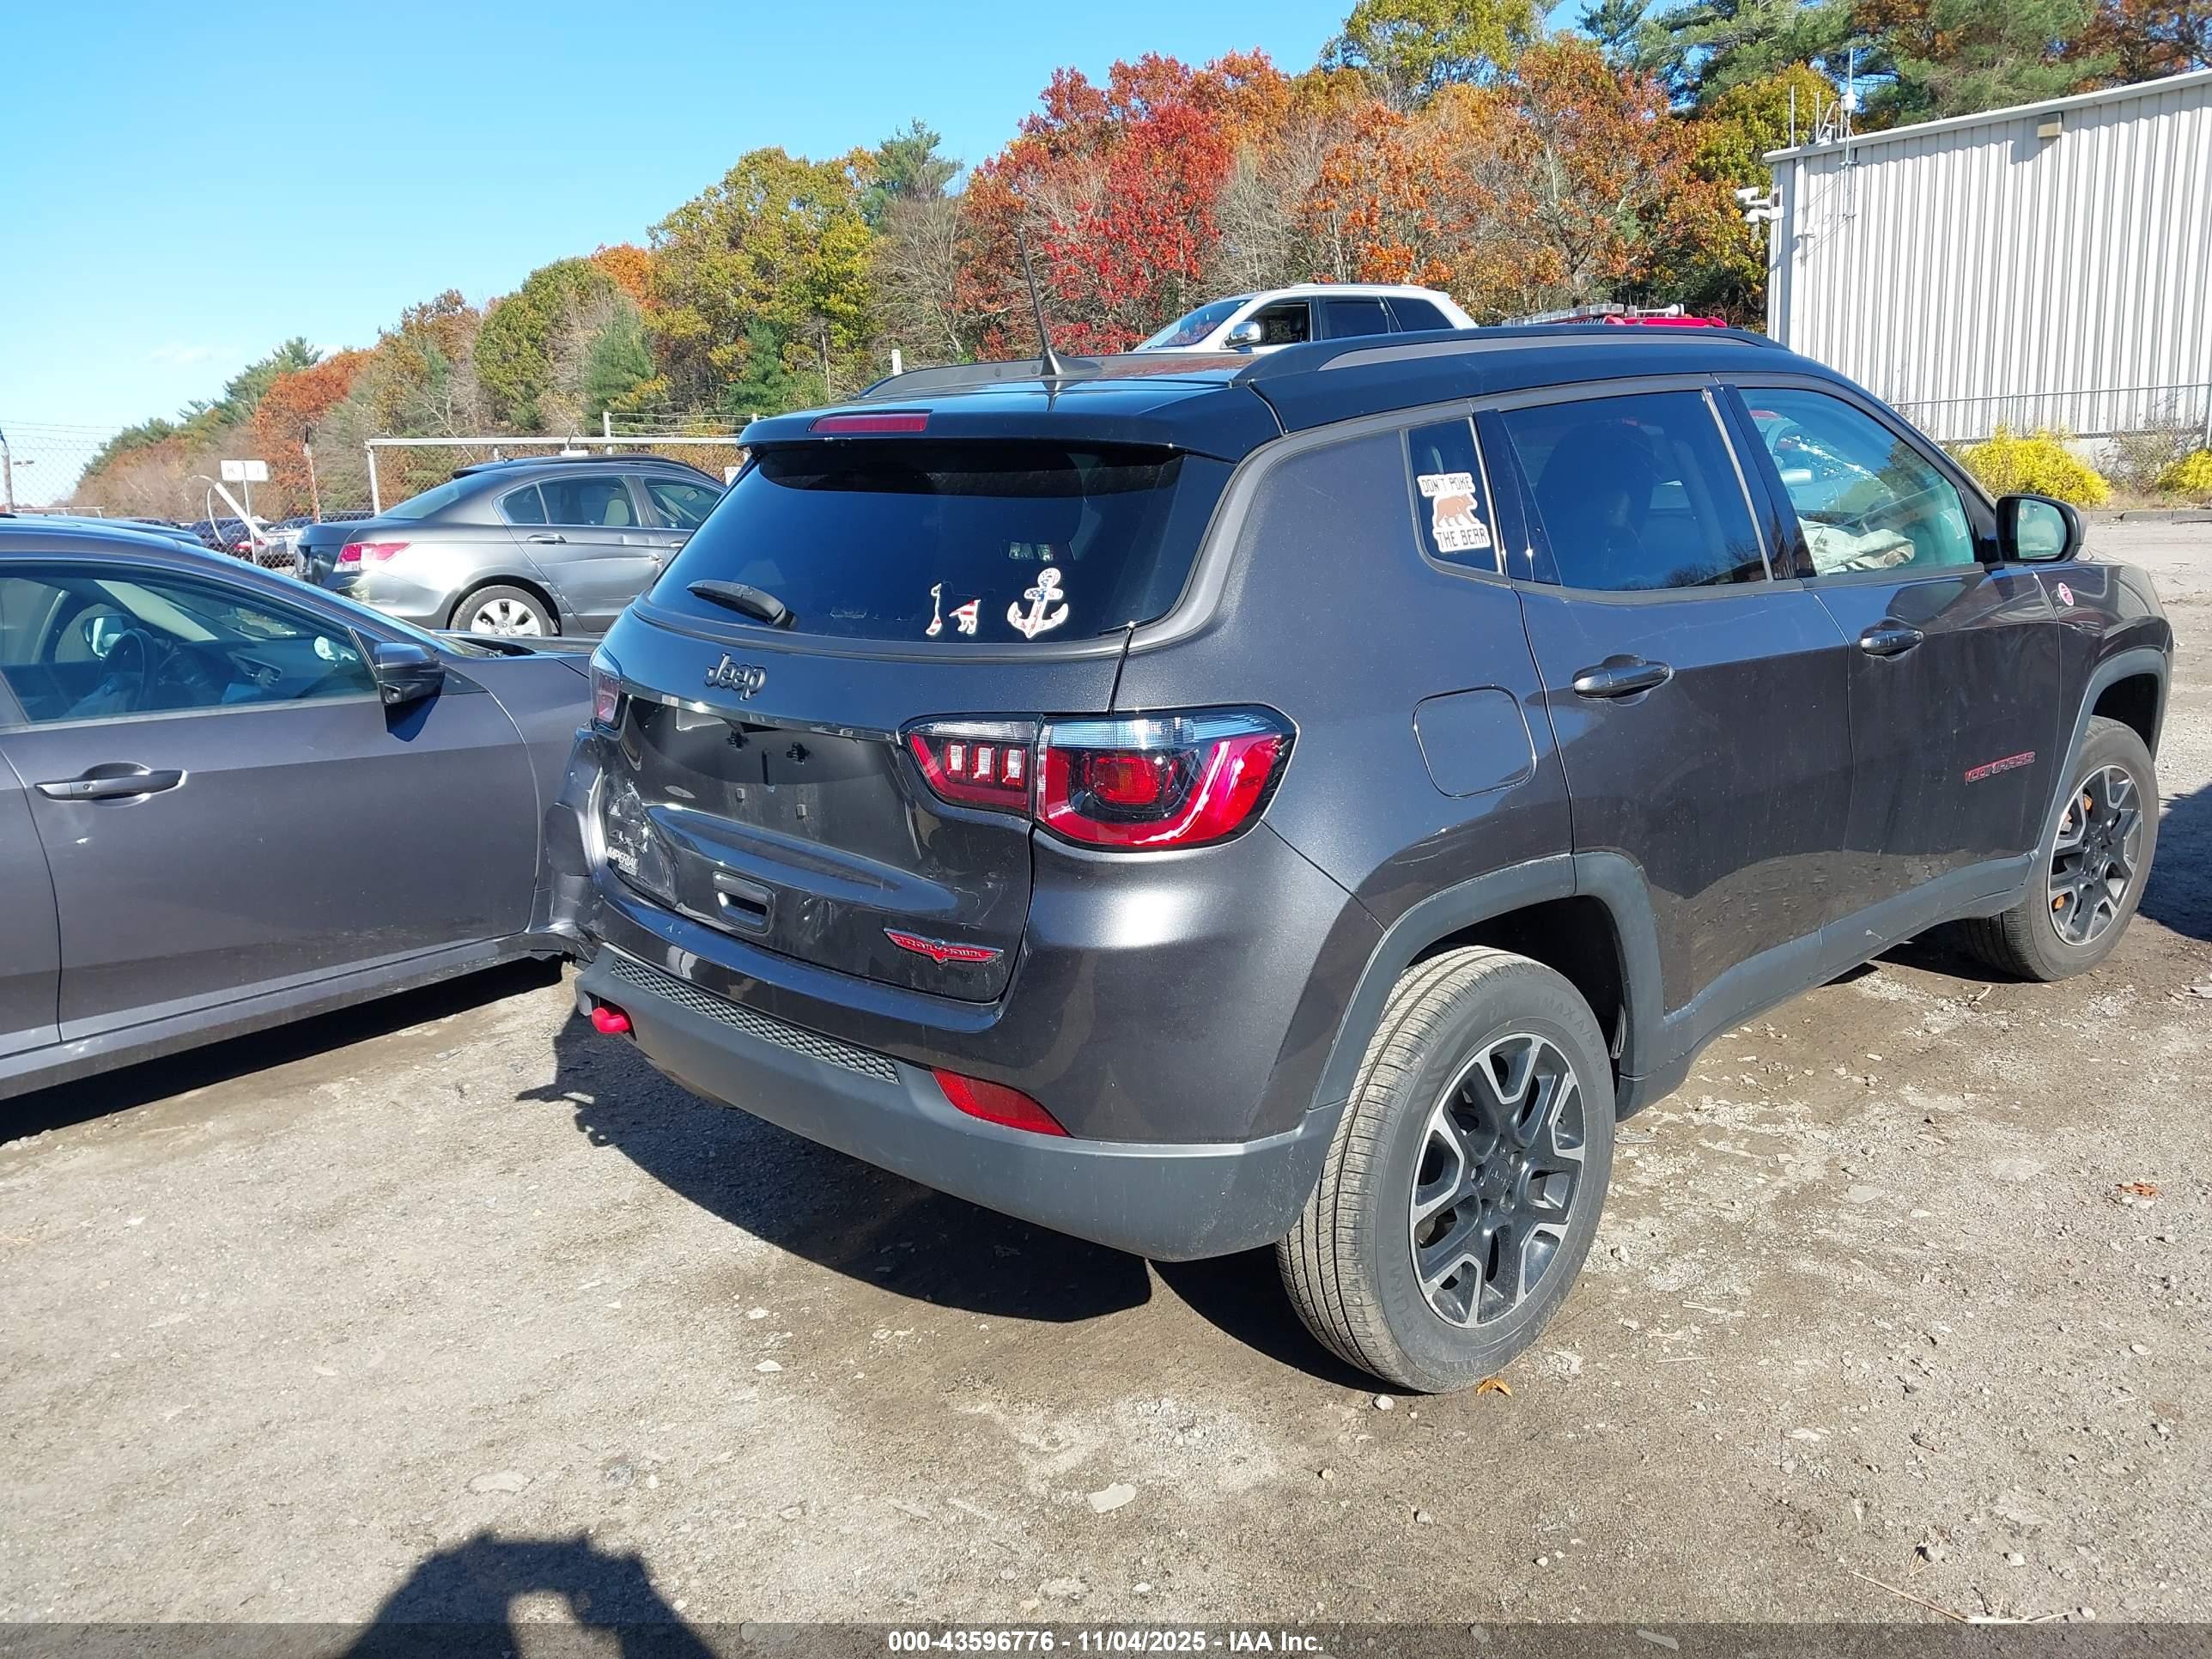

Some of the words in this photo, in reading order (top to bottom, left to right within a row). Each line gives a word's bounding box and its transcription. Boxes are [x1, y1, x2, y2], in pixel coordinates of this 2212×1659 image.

[1449, 476, 1473, 491] POKE
[1436, 531, 1458, 548] THE
[1460, 527, 1488, 545] BEAR
[704, 652, 768, 702] Jeep
[606, 845, 639, 872] IMPERIAL
